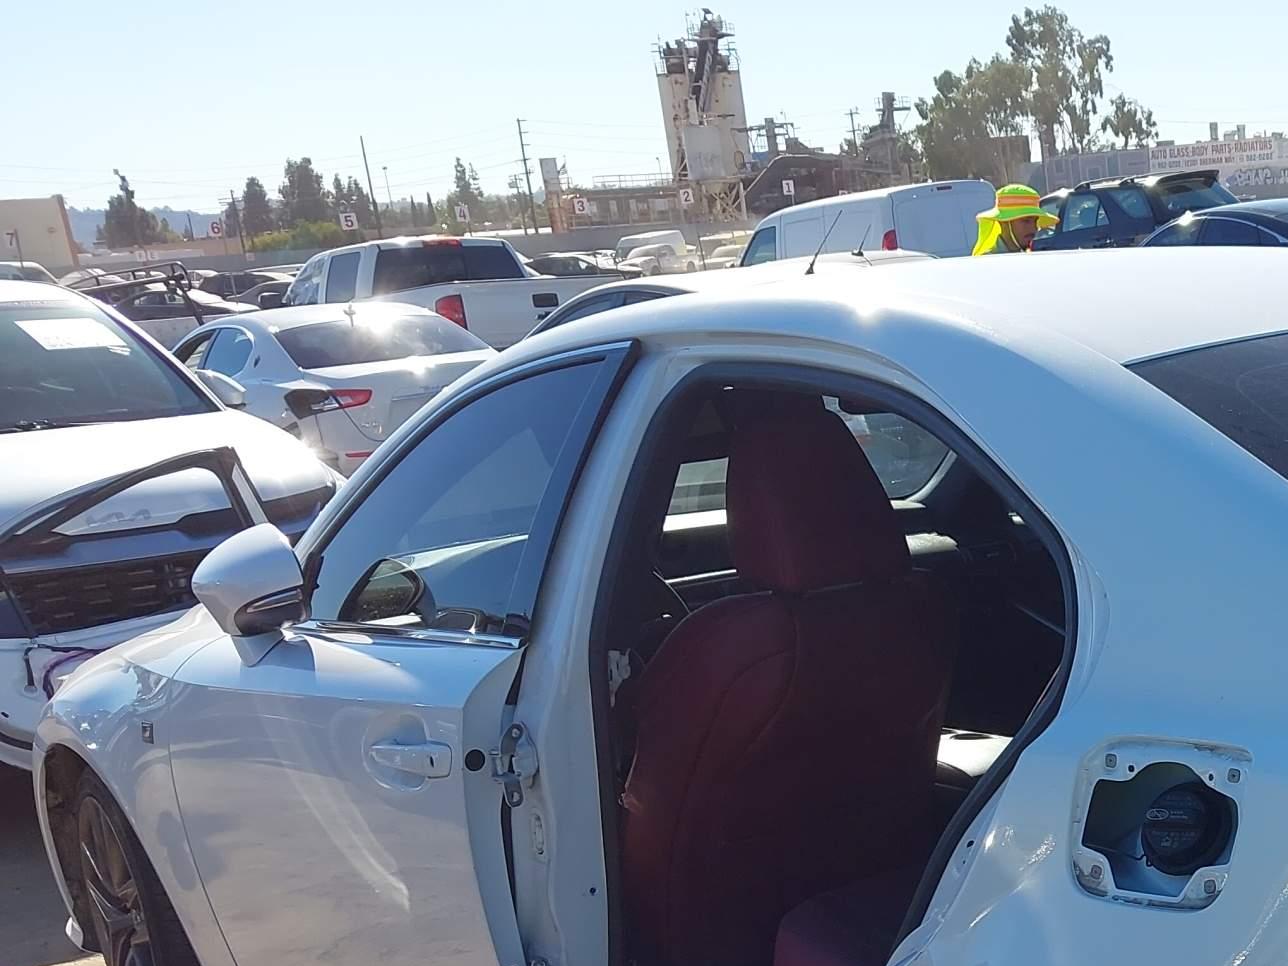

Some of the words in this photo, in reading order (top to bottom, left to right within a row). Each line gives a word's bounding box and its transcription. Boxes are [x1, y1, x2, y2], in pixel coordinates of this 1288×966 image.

[784, 182, 792, 193] 1
[682, 190, 691, 202] 2
[576, 200, 585, 212] 3
[459, 207, 467, 220] 4
[210, 221, 221, 234] 6
[344, 215, 354, 228] 5
[5, 231, 15, 247] 7
